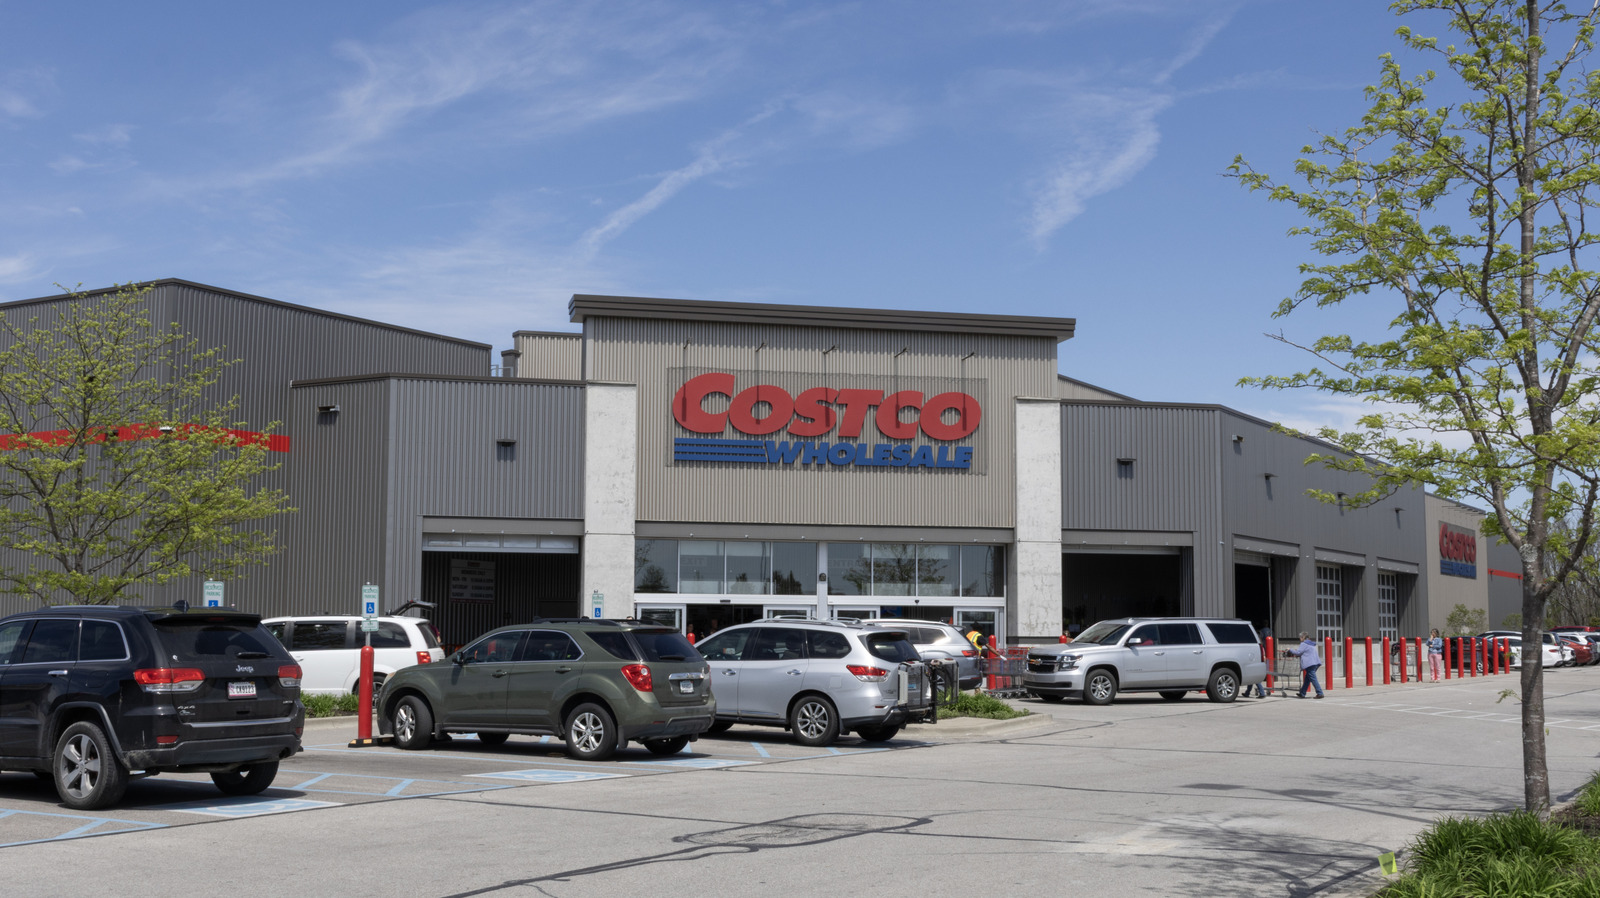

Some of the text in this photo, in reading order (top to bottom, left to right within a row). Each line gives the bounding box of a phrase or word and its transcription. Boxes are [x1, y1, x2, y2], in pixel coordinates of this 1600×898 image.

[672, 372, 982, 441] COSTCO
[765, 440, 974, 469] WHOLESALE
[1439, 524, 1476, 563] COSTCO
[236, 664, 254, 673] Jeep
